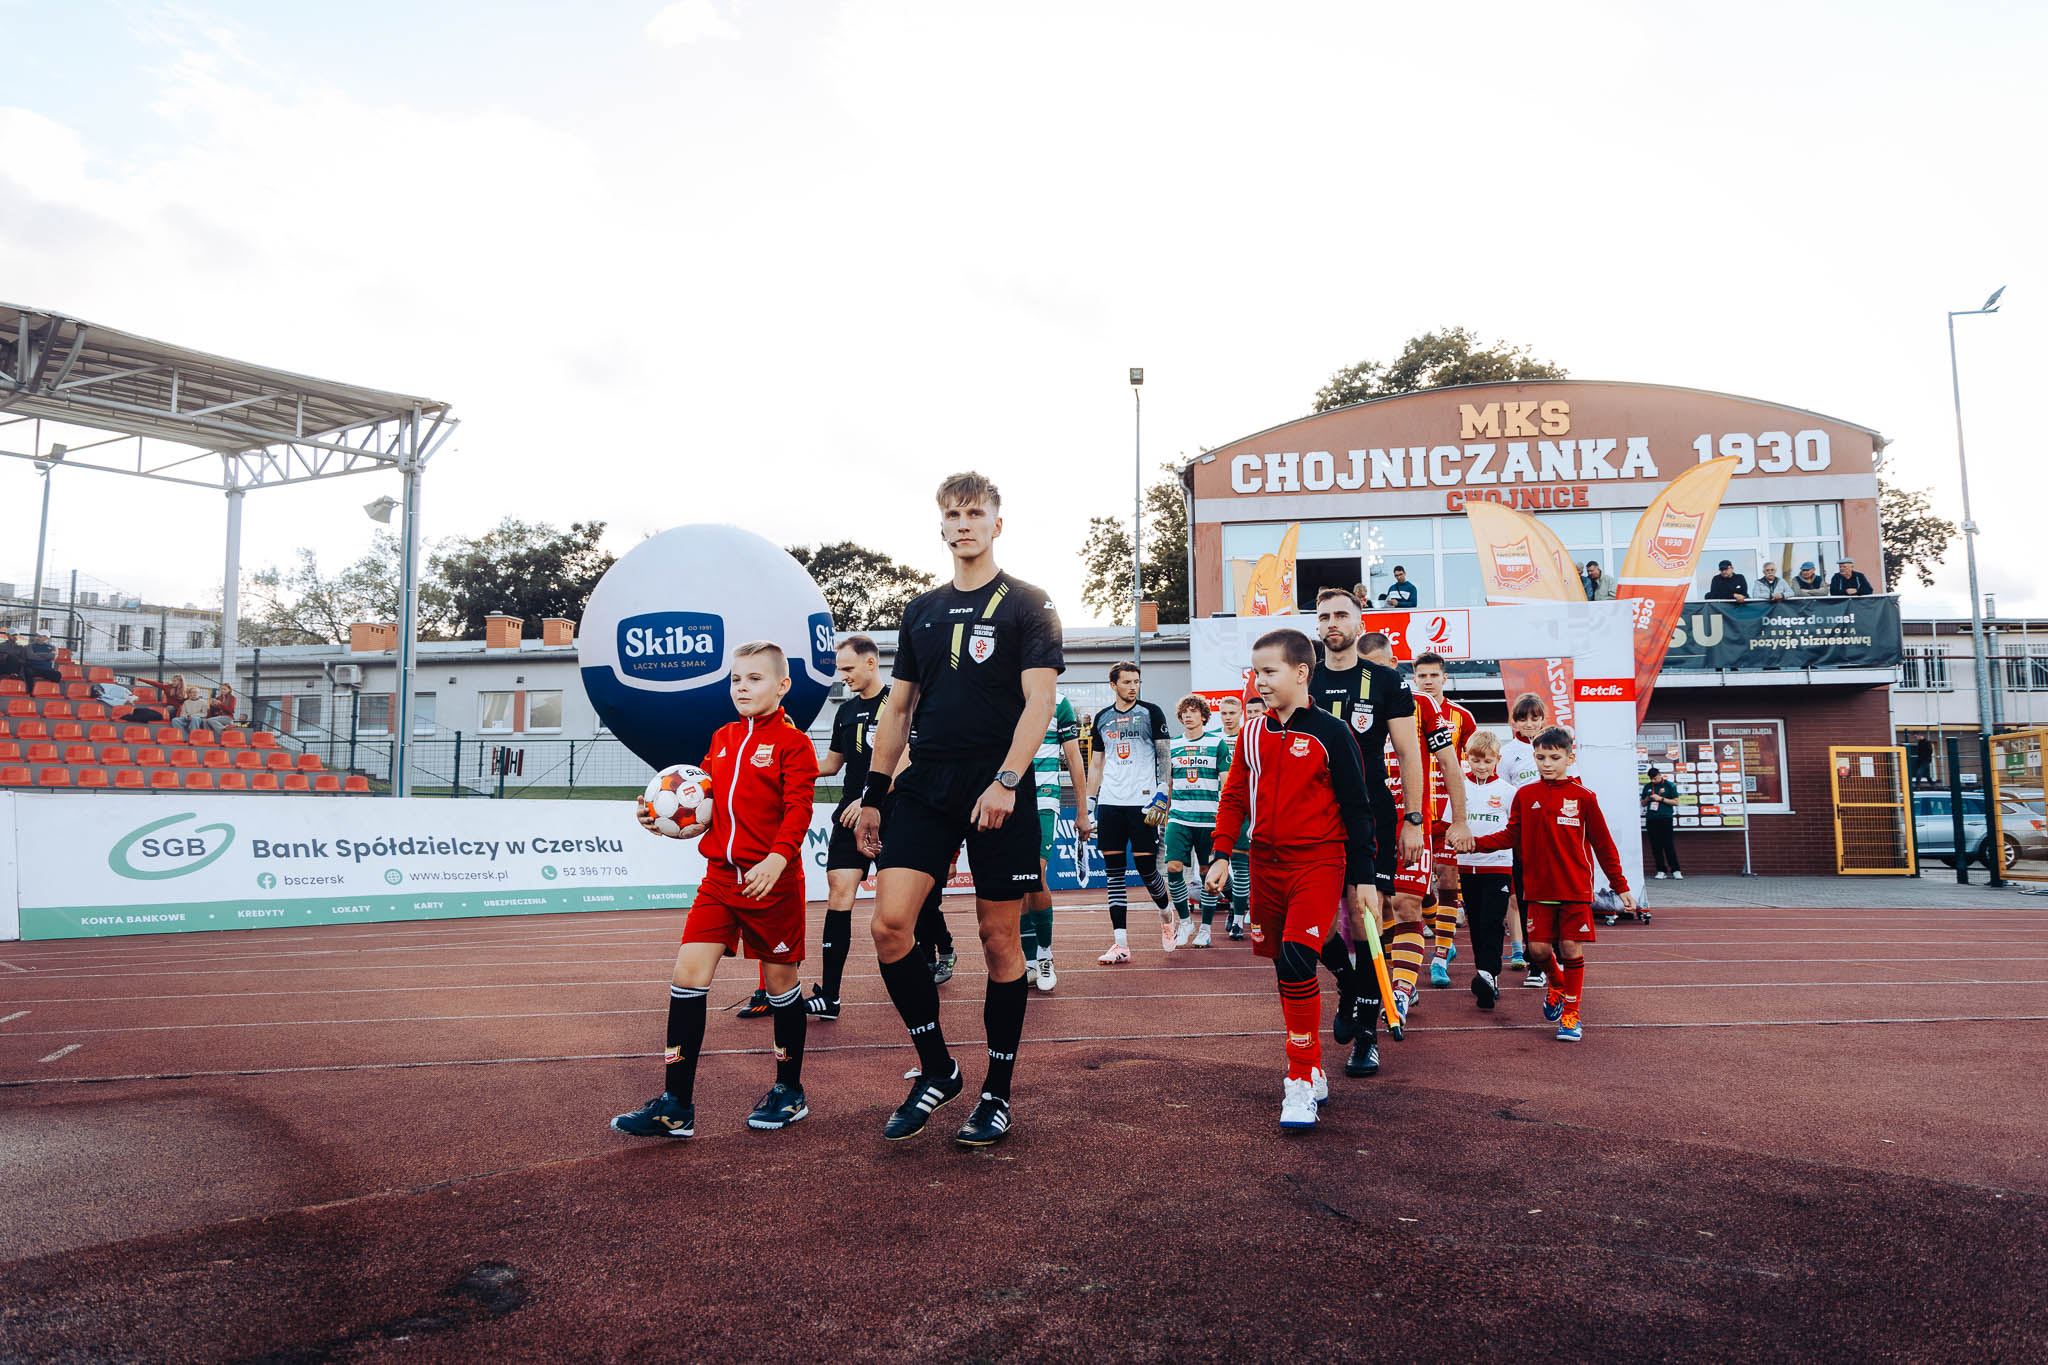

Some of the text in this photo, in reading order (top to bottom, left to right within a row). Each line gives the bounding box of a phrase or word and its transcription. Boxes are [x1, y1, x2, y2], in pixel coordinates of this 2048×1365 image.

[1459, 400, 1570, 439] MKS
[1231, 429, 1831, 494] CHOJNICZANKA 1930
[1637, 599, 1656, 630] 1930
[1762, 613, 1855, 628] Dołącz do nas!
[1816, 627, 1857, 635] SWOJĄ
[625, 626, 714, 657] Skiba
[1750, 635, 1872, 650] pozycję biznesową
[1434, 645, 1453, 654] LIGA
[633, 660, 707, 671] ŁĄCZY NAS SMAK
[1580, 685, 1623, 696] Betclic
[1105, 729, 1140, 740] Rolplan
[1178, 757, 1208, 766] Rolplan
[1467, 813, 1500, 822] INTER
[142, 838, 206, 857] SGB
[252, 836, 624, 863] Bank Spółdzielczy w Czersku
[410, 870, 508, 882] www.bsczersk.pl
[563, 866, 628, 876] 52 396 77 06
[284, 874, 345, 885] bsczersk
[414, 902, 444, 910] KARTY
[484, 898, 547, 907] UBEZPIECZENIA
[238, 909, 285, 918] KREDYTY
[332, 905, 371, 914] LOKATY
[81, 913, 186, 925] KONTA BANKOWE
